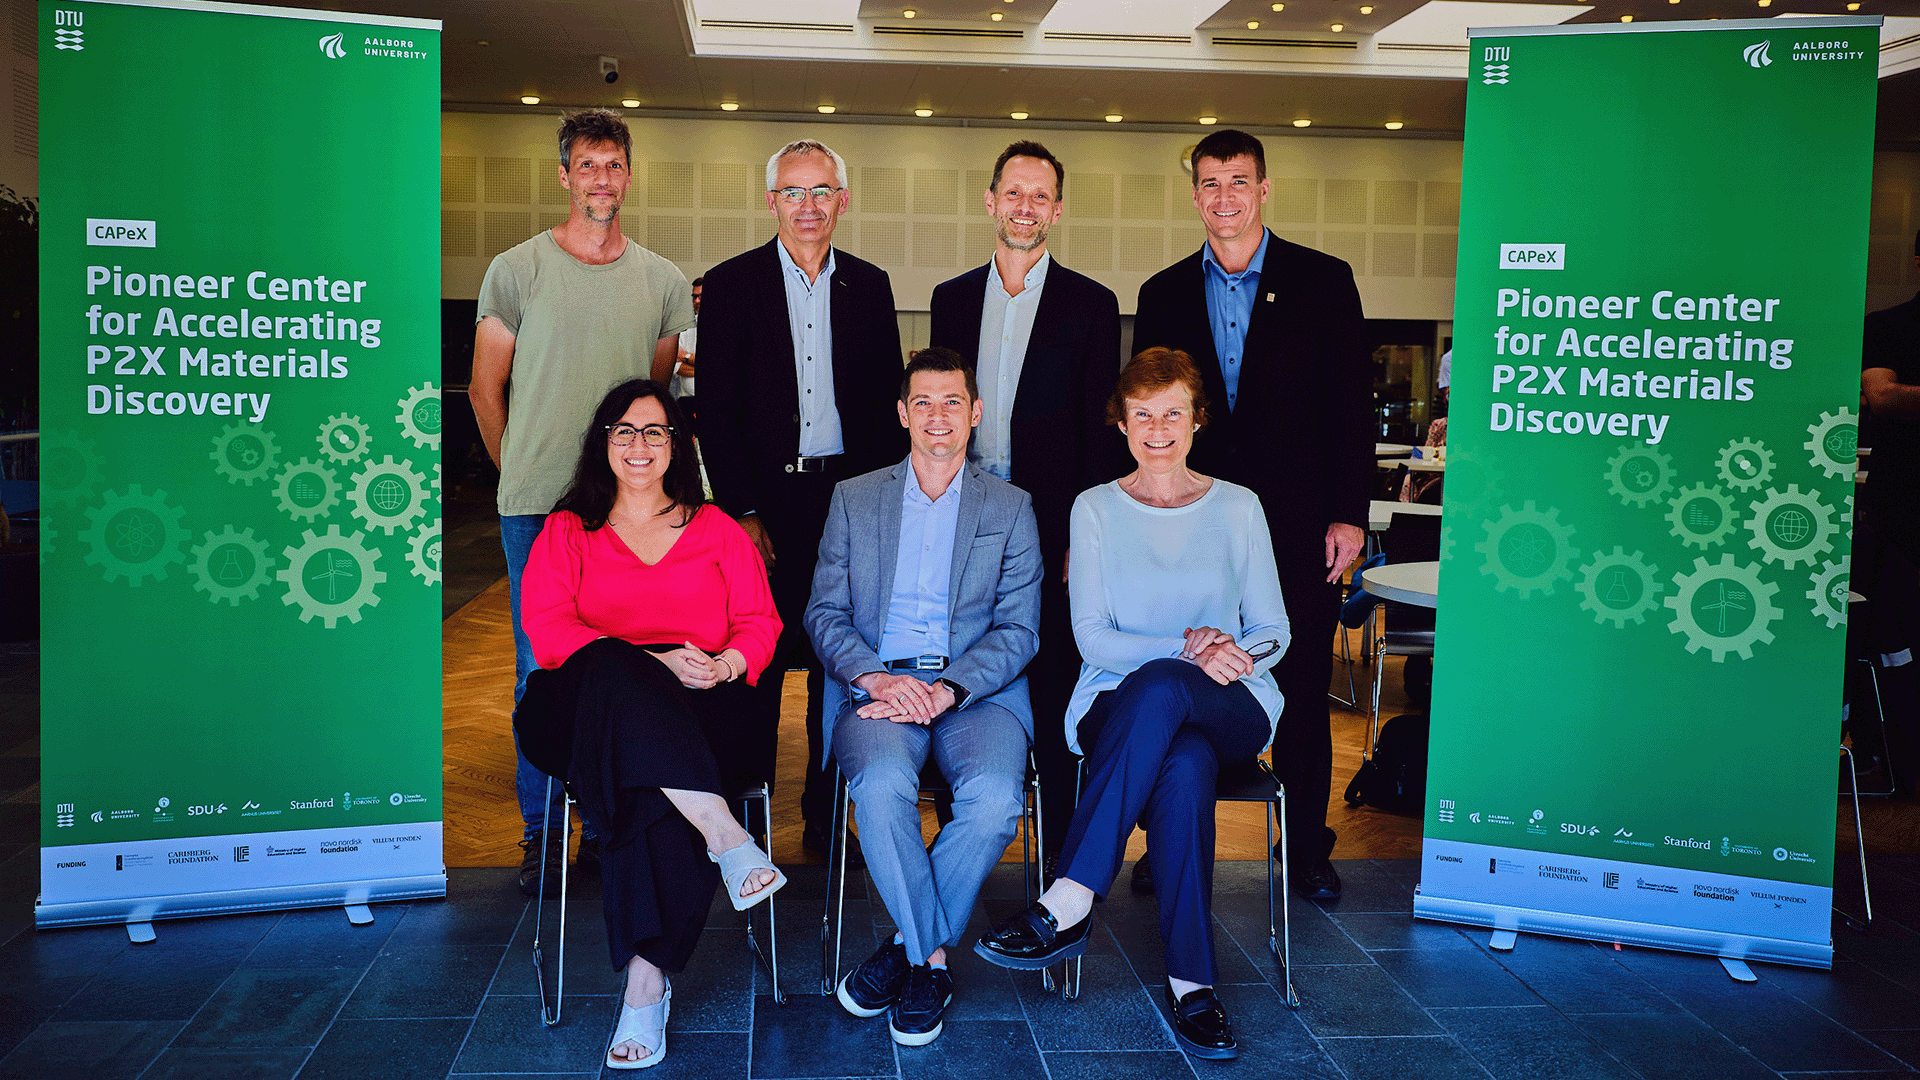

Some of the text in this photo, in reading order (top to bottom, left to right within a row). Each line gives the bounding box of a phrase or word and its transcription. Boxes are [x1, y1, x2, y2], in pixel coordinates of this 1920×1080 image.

[55, 10, 83, 27] DTU
[364, 37, 414, 48] AALBORG
[1793, 41, 1849, 50] AALBORG
[364, 48, 427, 60] UNIVERSITY
[1484, 47, 1510, 62] DTU
[1793, 51, 1864, 61] UNIVERSITY
[95, 225, 148, 241] CAPeX
[1507, 250, 1557, 263] CAPeX
[87, 265, 367, 303] Pioneer Center
[1497, 288, 1780, 322] Pioneer Center
[85, 305, 382, 348] for Accelerating
[1494, 326, 1794, 370] for Accelerating
[87, 345, 348, 378] P2X Materials
[1492, 365, 1754, 401] P2X Materials
[87, 384, 271, 422] Discovery
[1490, 403, 1670, 445] Discovery
[57, 803, 74, 813] DTU
[290, 798, 334, 809] Stanford
[1440, 799, 1455, 809] DTU
[188, 805, 214, 816] SDU
[1560, 823, 1586, 835] SDU
[1664, 836, 1710, 850] Stanford
[168, 849, 211, 858] CARLSBERG
[321, 845, 358, 854] foundation
[1732, 847, 1762, 855] TORONTO
[169, 855, 219, 864] FOUNDATION
[1436, 855, 1462, 863] FUNDING
[1539, 865, 1580, 875] CARLSBERG
[1539, 872, 1588, 882] FOUNDATION
[1693, 890, 1735, 901] foundation
[1713, 886, 1739, 895] nordisk
[1751, 892, 1806, 904] VILLUM FONDEN
